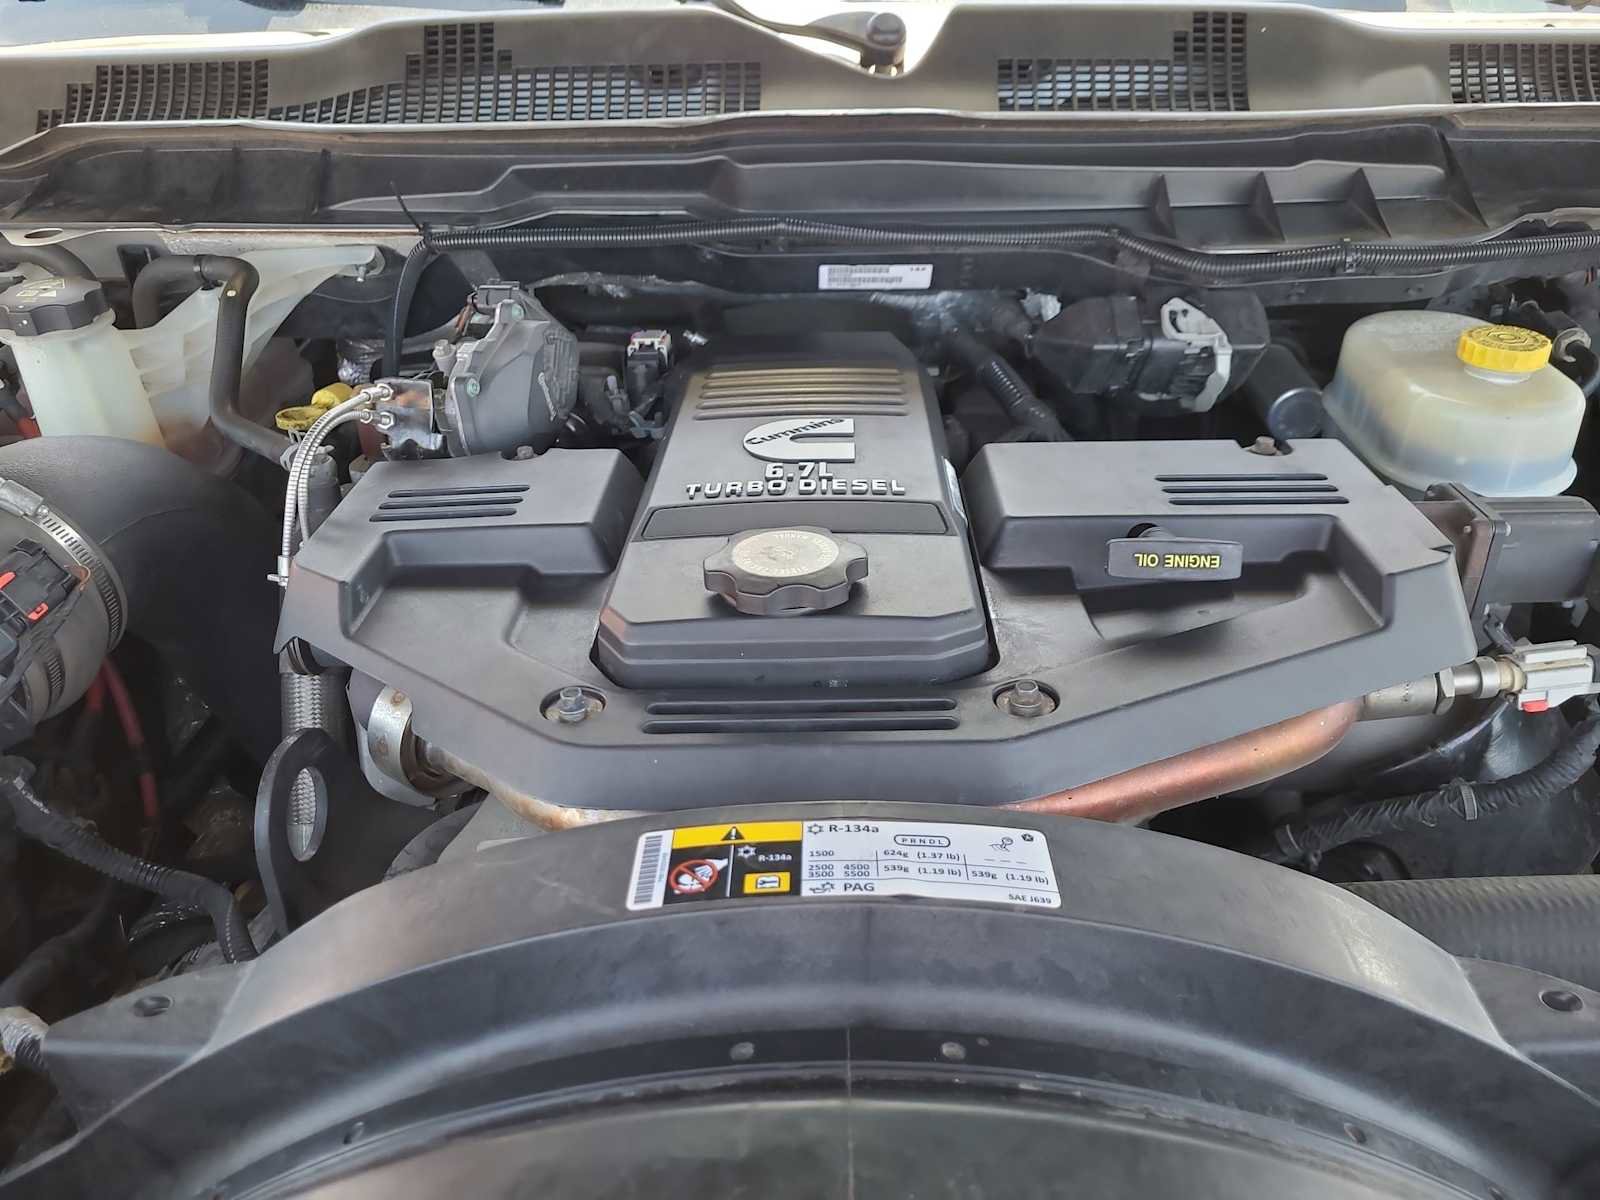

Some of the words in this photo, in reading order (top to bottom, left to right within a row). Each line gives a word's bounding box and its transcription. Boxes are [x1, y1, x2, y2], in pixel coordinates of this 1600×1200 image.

[745, 418, 845, 446] Cummins
[764, 462, 834, 481] 6.7L
[686, 480, 788, 499] TURBO
[799, 479, 906, 496] DIESEL
[1133, 553, 1160, 568] OIL
[1163, 554, 1221, 569] ENGINE
[829, 824, 880, 833] R-134a
[758, 854, 792, 862] R-134a
[883, 849, 909, 859] 624g
[917, 851, 943, 859] (1.37
[946, 852, 960, 861] lb)
[808, 863, 835, 871] 2500
[843, 863, 870, 871] 4500
[883, 865, 909, 873] 539g
[918, 866, 945, 875] (1.19
[947, 868, 962, 877] lb)
[808, 870, 835, 878] 3500
[843, 870, 870, 878] 5500
[971, 870, 998, 880] 539g
[1005, 873, 1032, 882] (1.19
[1035, 875, 1050, 885] lb)
[843, 882, 876, 892] PAG
[1008, 893, 1026, 901] SAE
